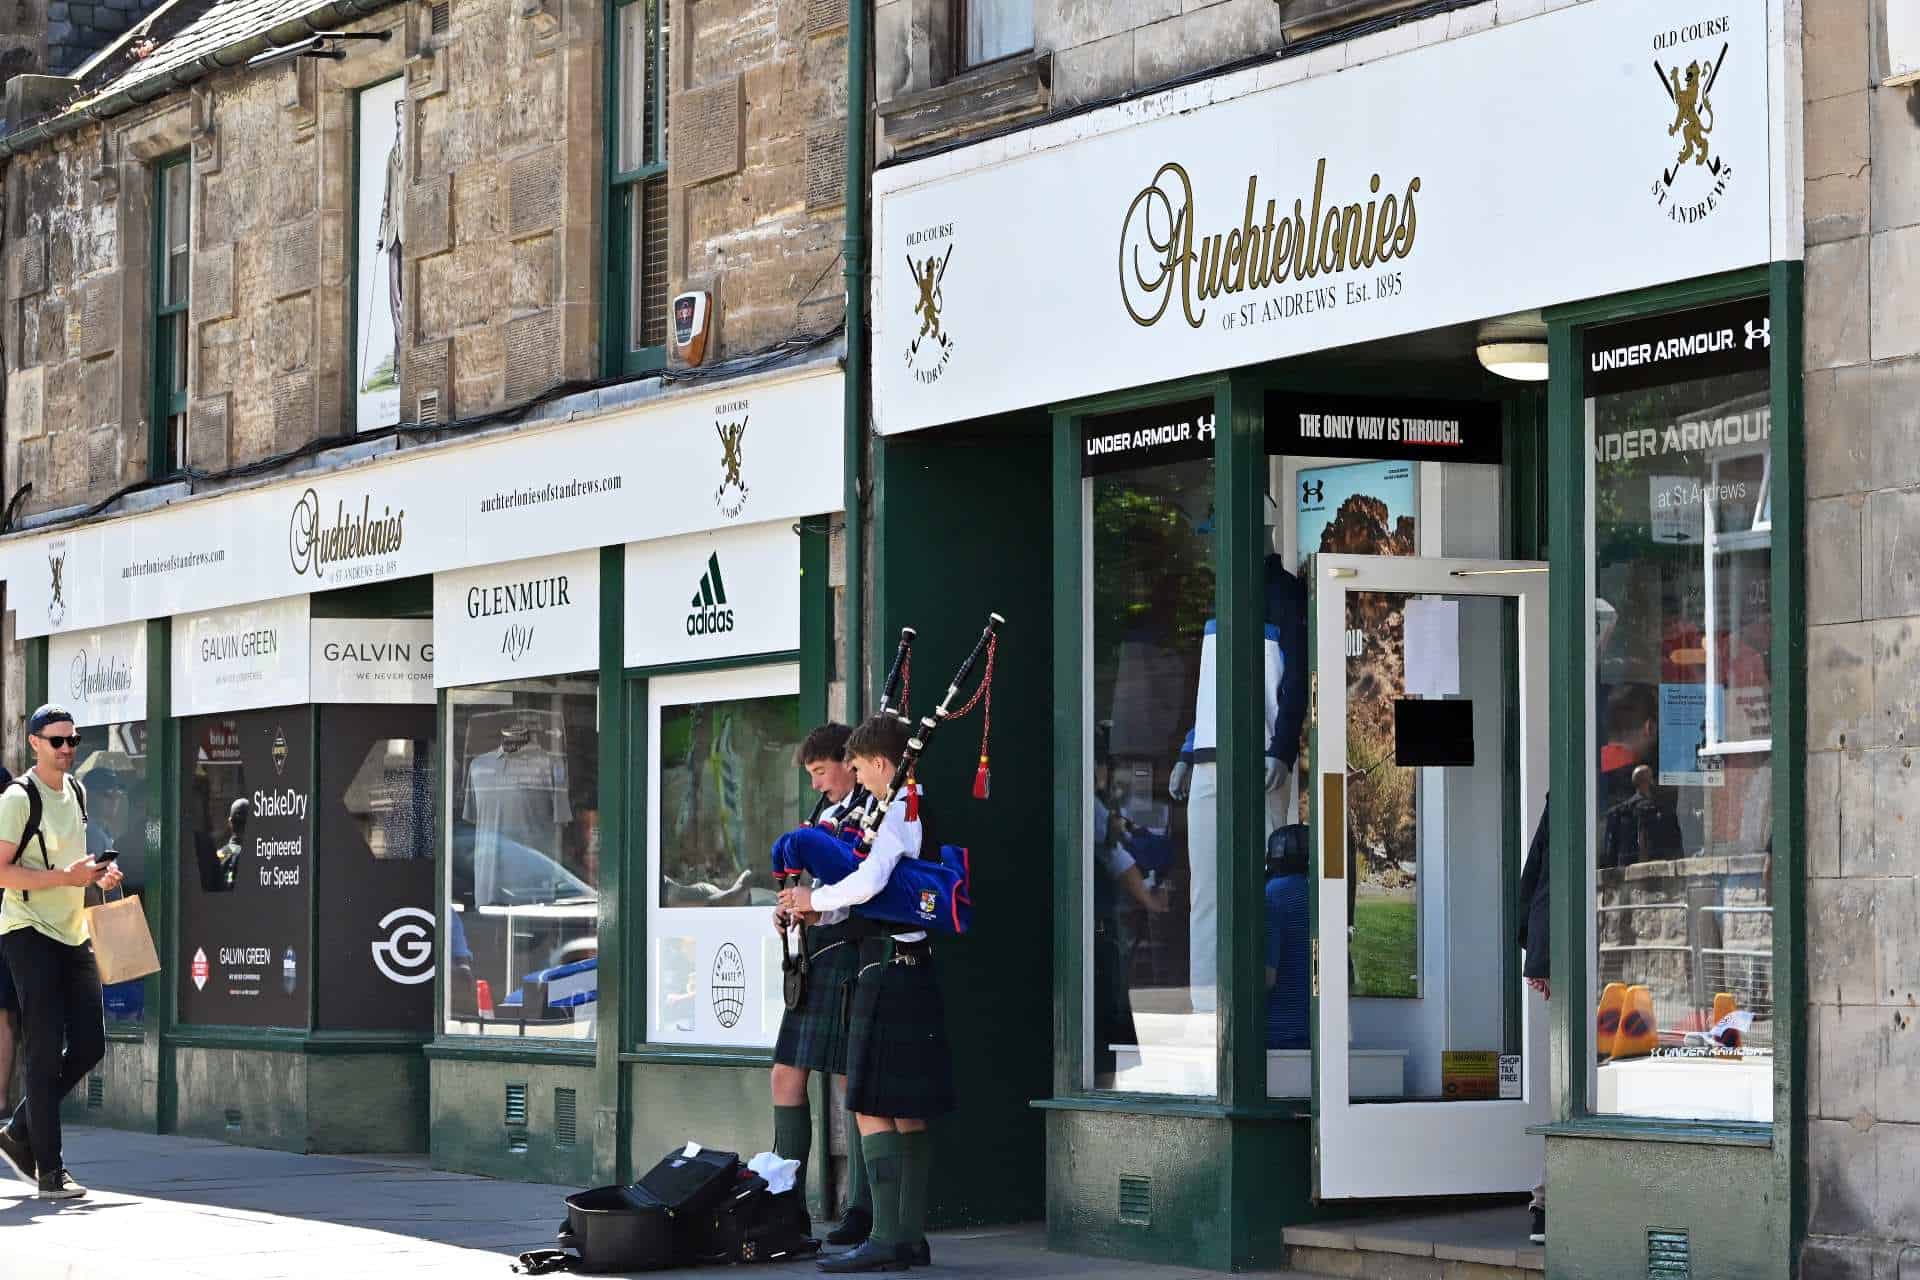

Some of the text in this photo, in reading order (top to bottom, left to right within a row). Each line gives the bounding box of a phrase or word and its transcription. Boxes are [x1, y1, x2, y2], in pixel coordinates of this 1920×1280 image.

[1653, 16, 1730, 50] OLD COURSE
[1651, 163, 1732, 223] ST ANDREWS
[906, 222, 954, 247] OLD COURSE
[1119, 158, 1421, 328] Auchterlonies
[1222, 271, 1402, 330] OF ST ANDREWS Est. 1895
[1591, 343, 1651, 372] UNDER
[1299, 414, 1321, 438] THE
[1323, 415, 1354, 439] ONLY
[1356, 417, 1385, 441] WAY
[1387, 417, 1400, 441] IS
[1087, 432, 1131, 456] UNDER
[480, 473, 623, 514] auchterloniesofstandrews.com
[1657, 490, 1671, 508] at
[289, 487, 405, 579] Auchterlonies
[467, 575, 571, 619] GLENMUIR
[686, 606, 735, 636] adidas
[201, 628, 278, 662] GALVIN GREEN
[323, 642, 411, 662] GALVIN
[502, 623, 535, 663] 1891
[253, 789, 308, 820] ShakeDry
[256, 836, 302, 860] Engineered
[260, 866, 300, 888] for Speed
[219, 947, 271, 965] GALVIN GREEN
[1501, 1065, 1514, 1073] TAX
